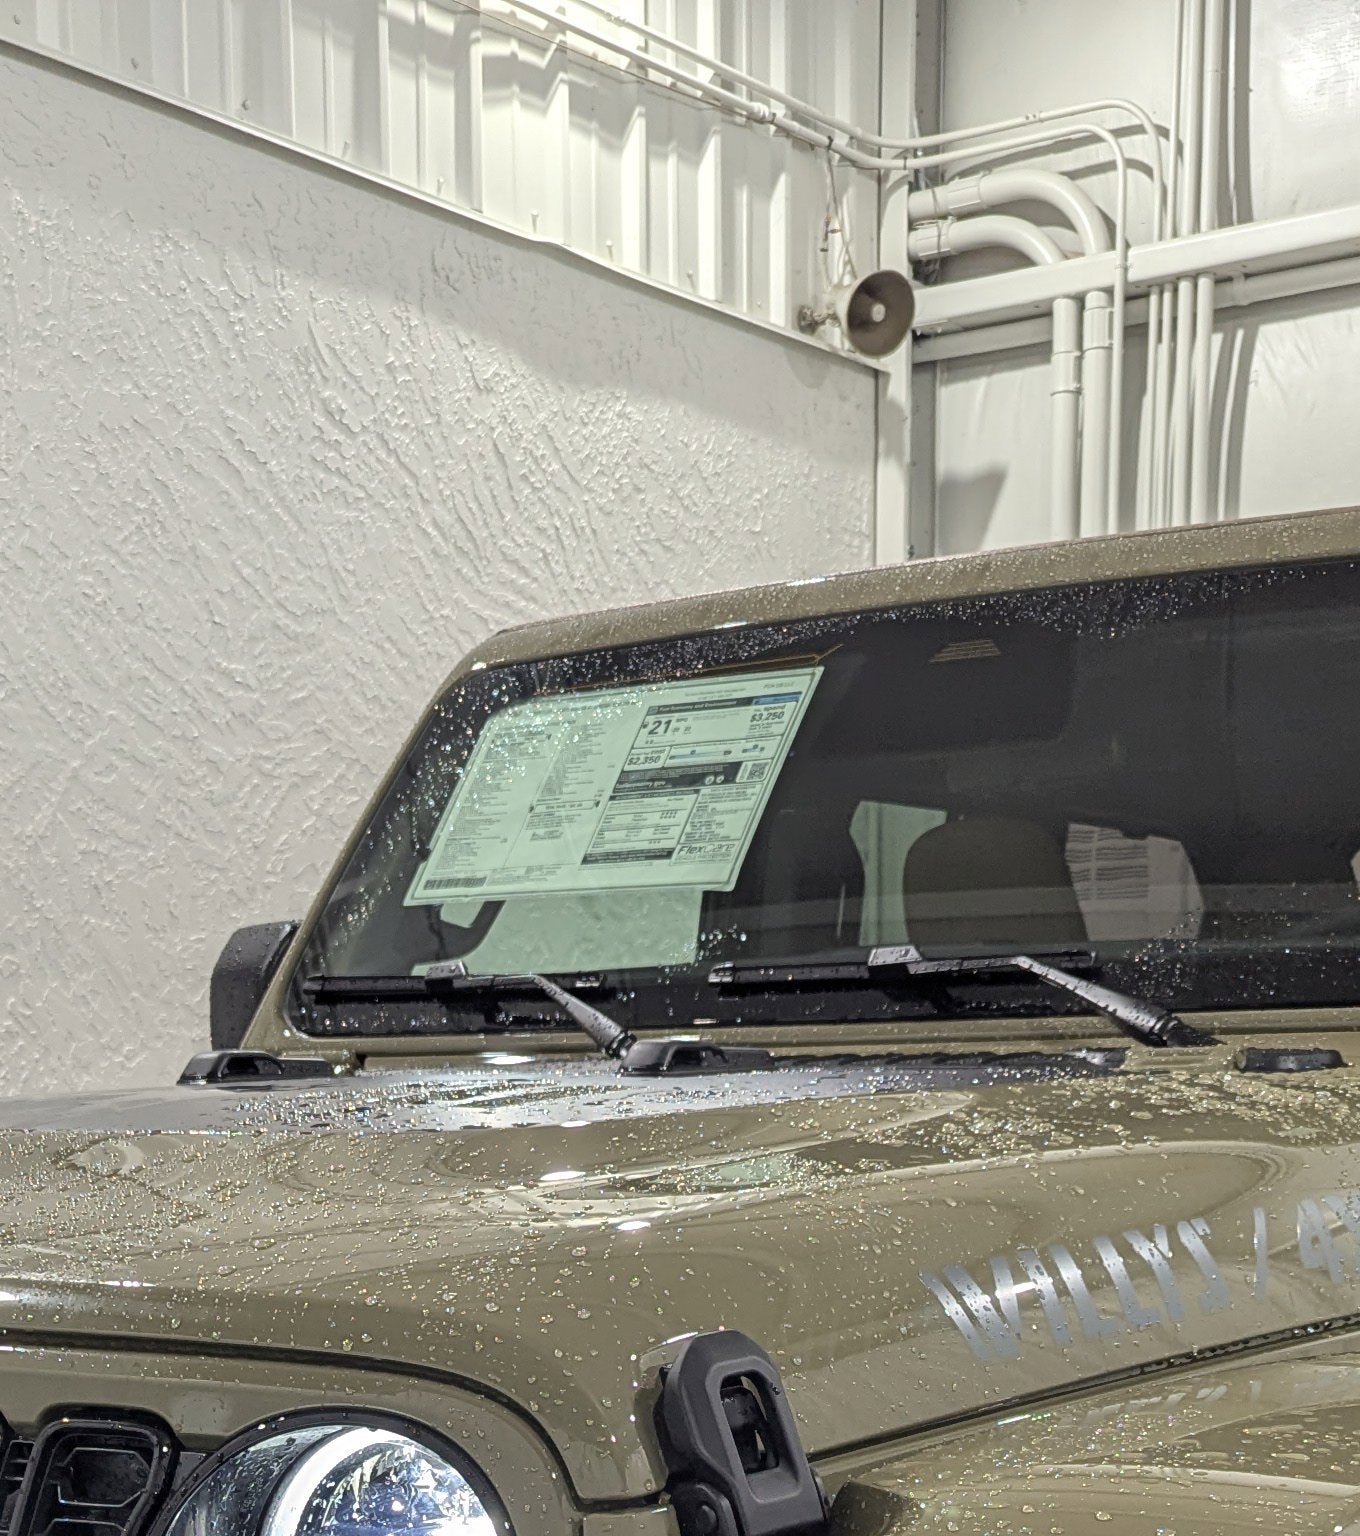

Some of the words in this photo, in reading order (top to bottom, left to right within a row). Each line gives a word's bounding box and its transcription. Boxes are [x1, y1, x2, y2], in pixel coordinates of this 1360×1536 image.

[750, 710, 785, 723] $3,250
[648, 719, 672, 735] 21
[917, 1215, 1231, 1364] WILLYS
